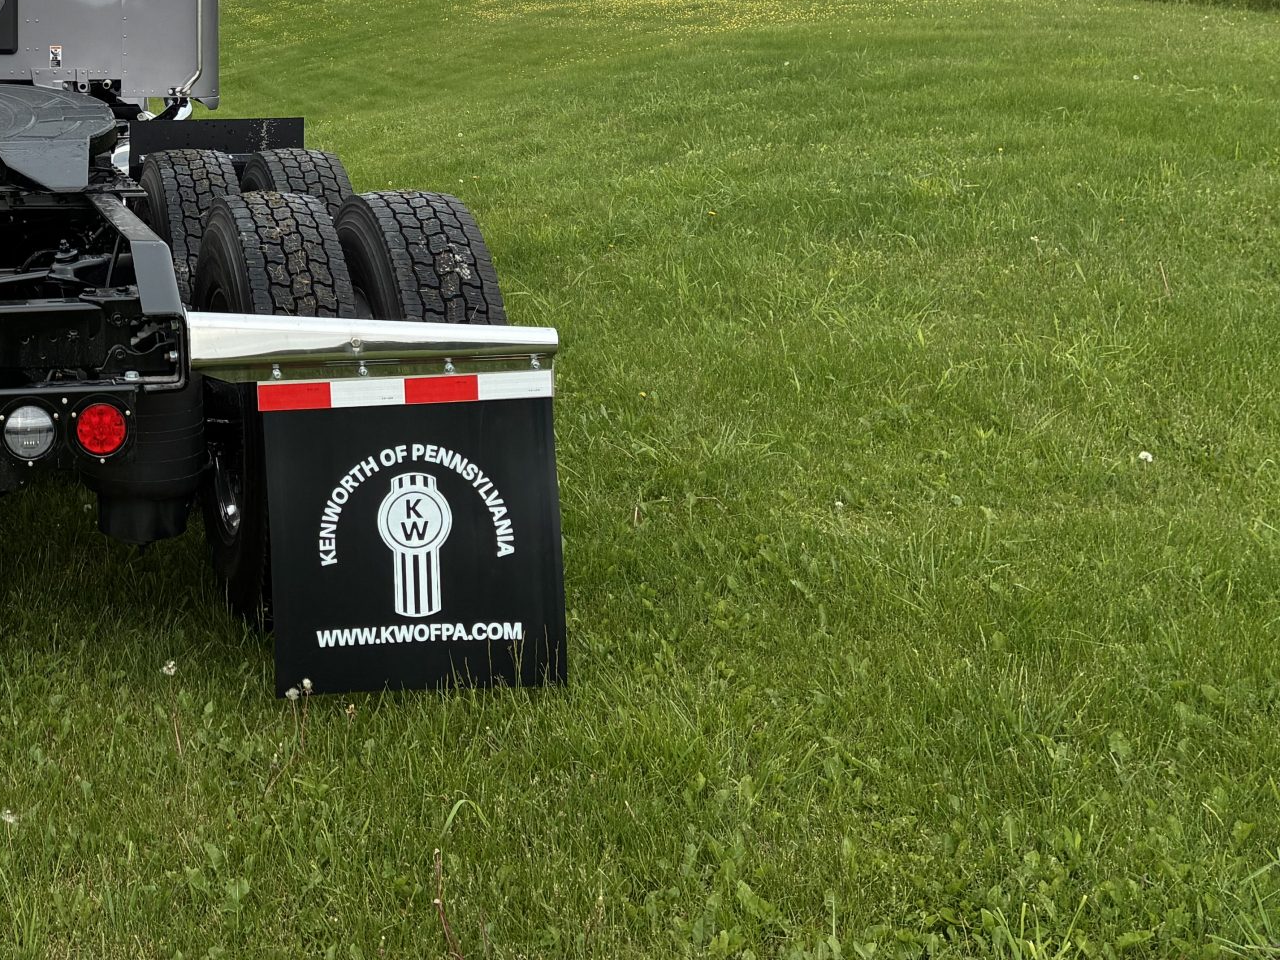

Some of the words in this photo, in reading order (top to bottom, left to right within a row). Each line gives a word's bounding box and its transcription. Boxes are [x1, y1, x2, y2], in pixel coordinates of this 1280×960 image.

[319, 455, 380, 567] KENWORTH
[379, 444, 408, 467] OF
[411, 443, 515, 558] PENNSYLVANIA
[405, 498, 423, 519] K
[400, 520, 429, 542] W
[316, 622, 523, 648] WWW.KWOFPA.COM
